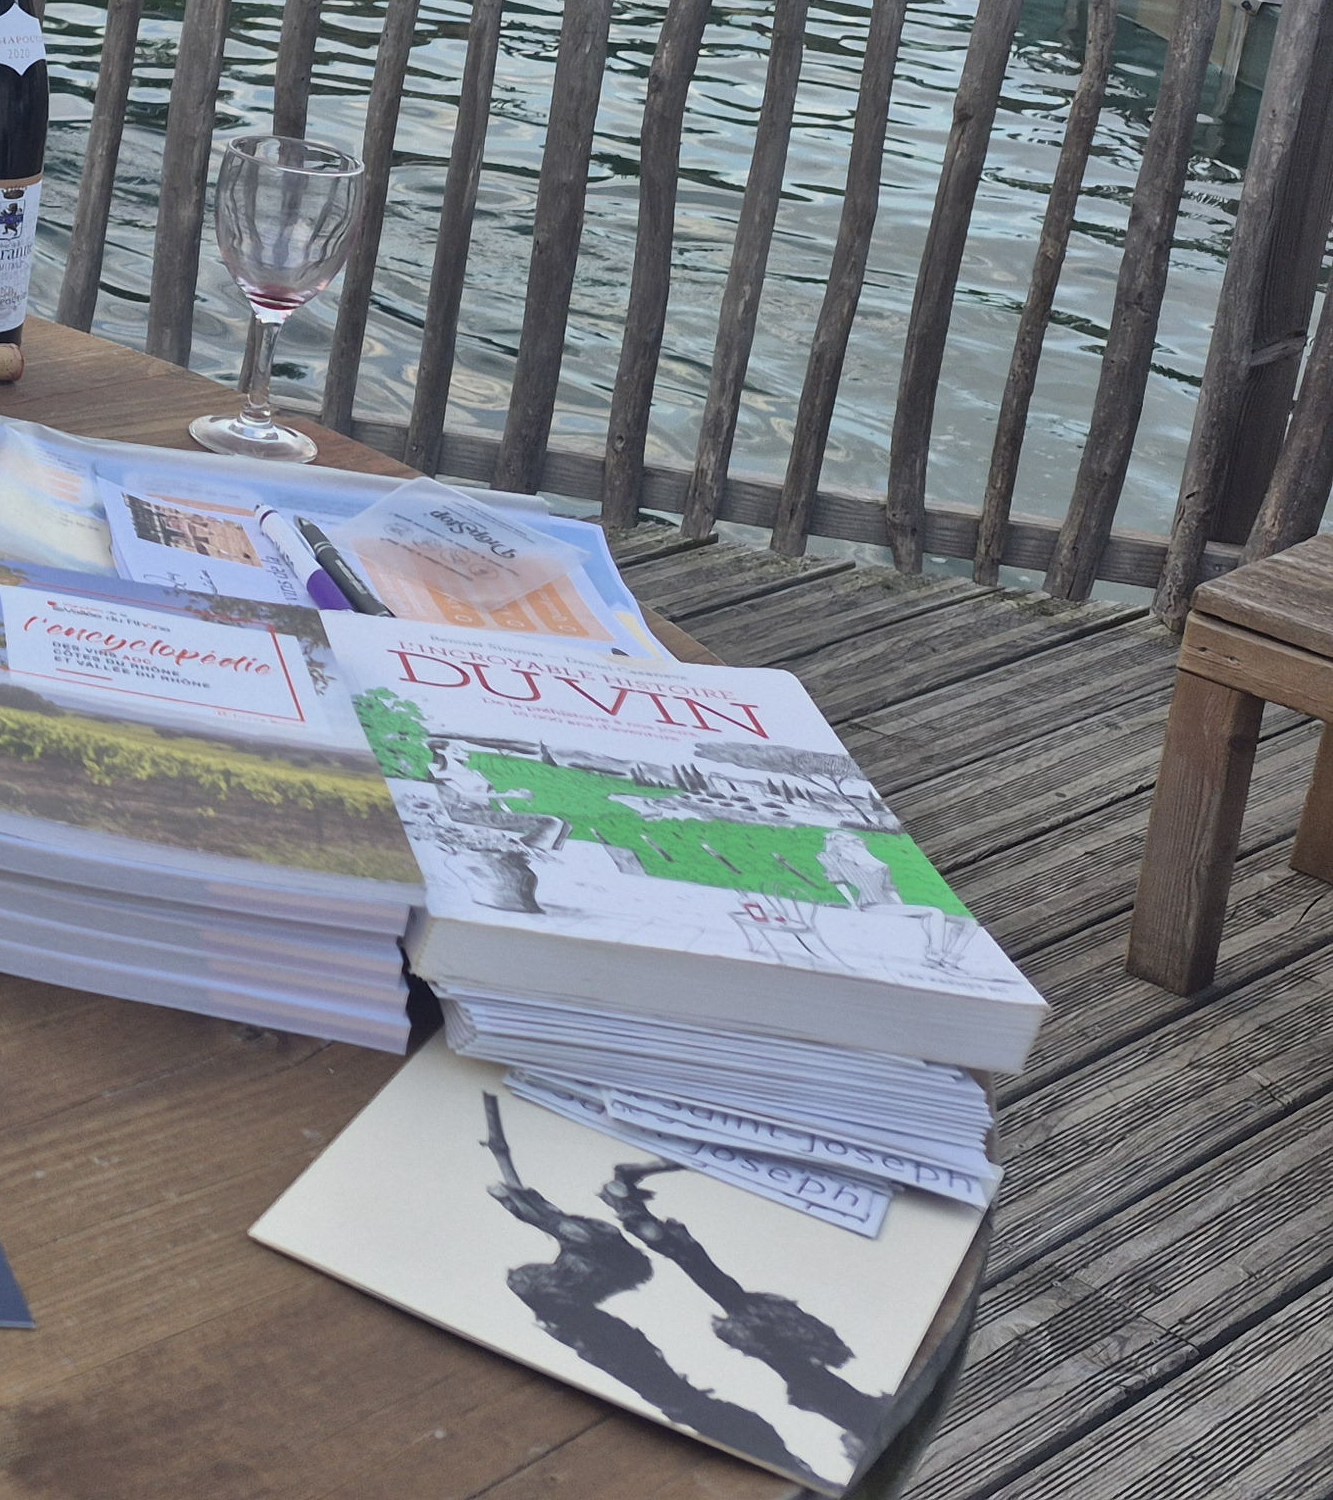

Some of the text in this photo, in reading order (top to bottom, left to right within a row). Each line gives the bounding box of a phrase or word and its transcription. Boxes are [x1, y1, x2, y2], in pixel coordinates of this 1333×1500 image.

[7, 48, 31, 60] 2020
[22, 614, 275, 677] l'encyclopédie
[85, 646, 118, 658] VINS
[398, 639, 739, 703] L'INCROYABLE HISTOIRE
[388, 648, 770, 740] DU VIN
